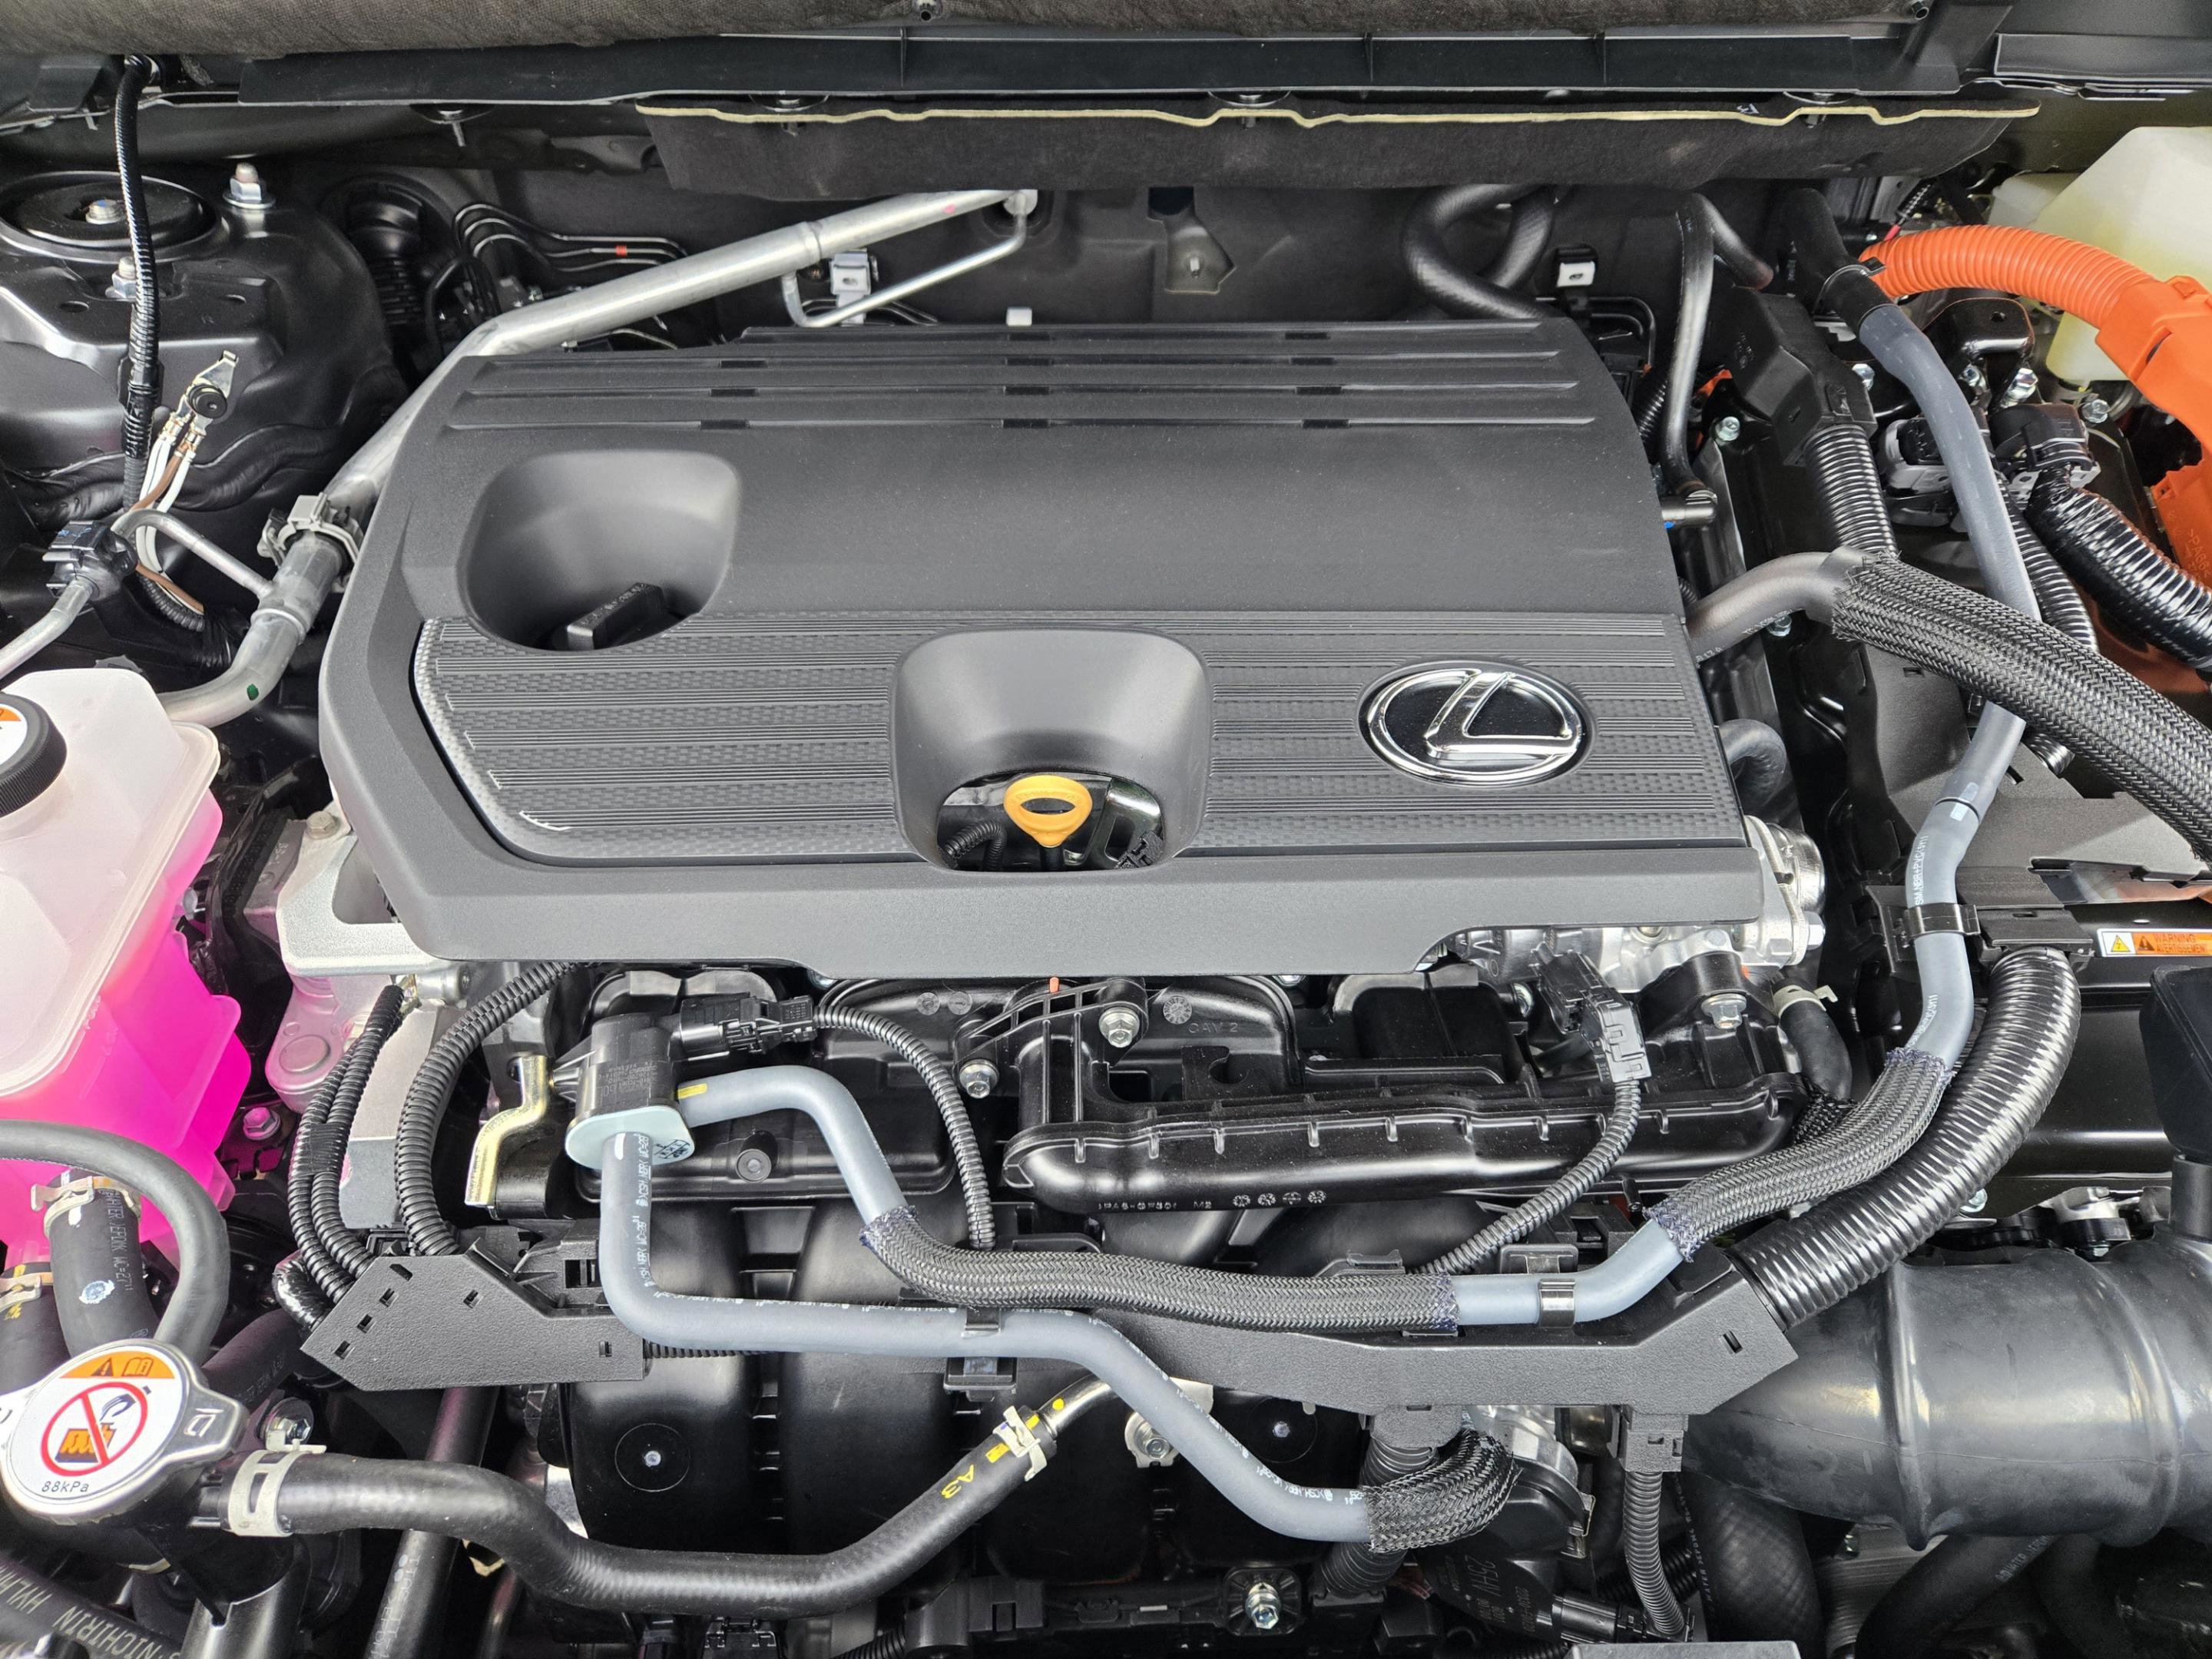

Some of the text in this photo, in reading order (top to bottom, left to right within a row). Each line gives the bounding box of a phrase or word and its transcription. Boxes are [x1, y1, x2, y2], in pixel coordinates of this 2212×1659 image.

[2153, 933, 2195, 942] WARNING
[1229, 1022, 1239, 1033] 2
[41, 1480, 90, 1493] 88kPa
[941, 1463, 975, 1500] A3
